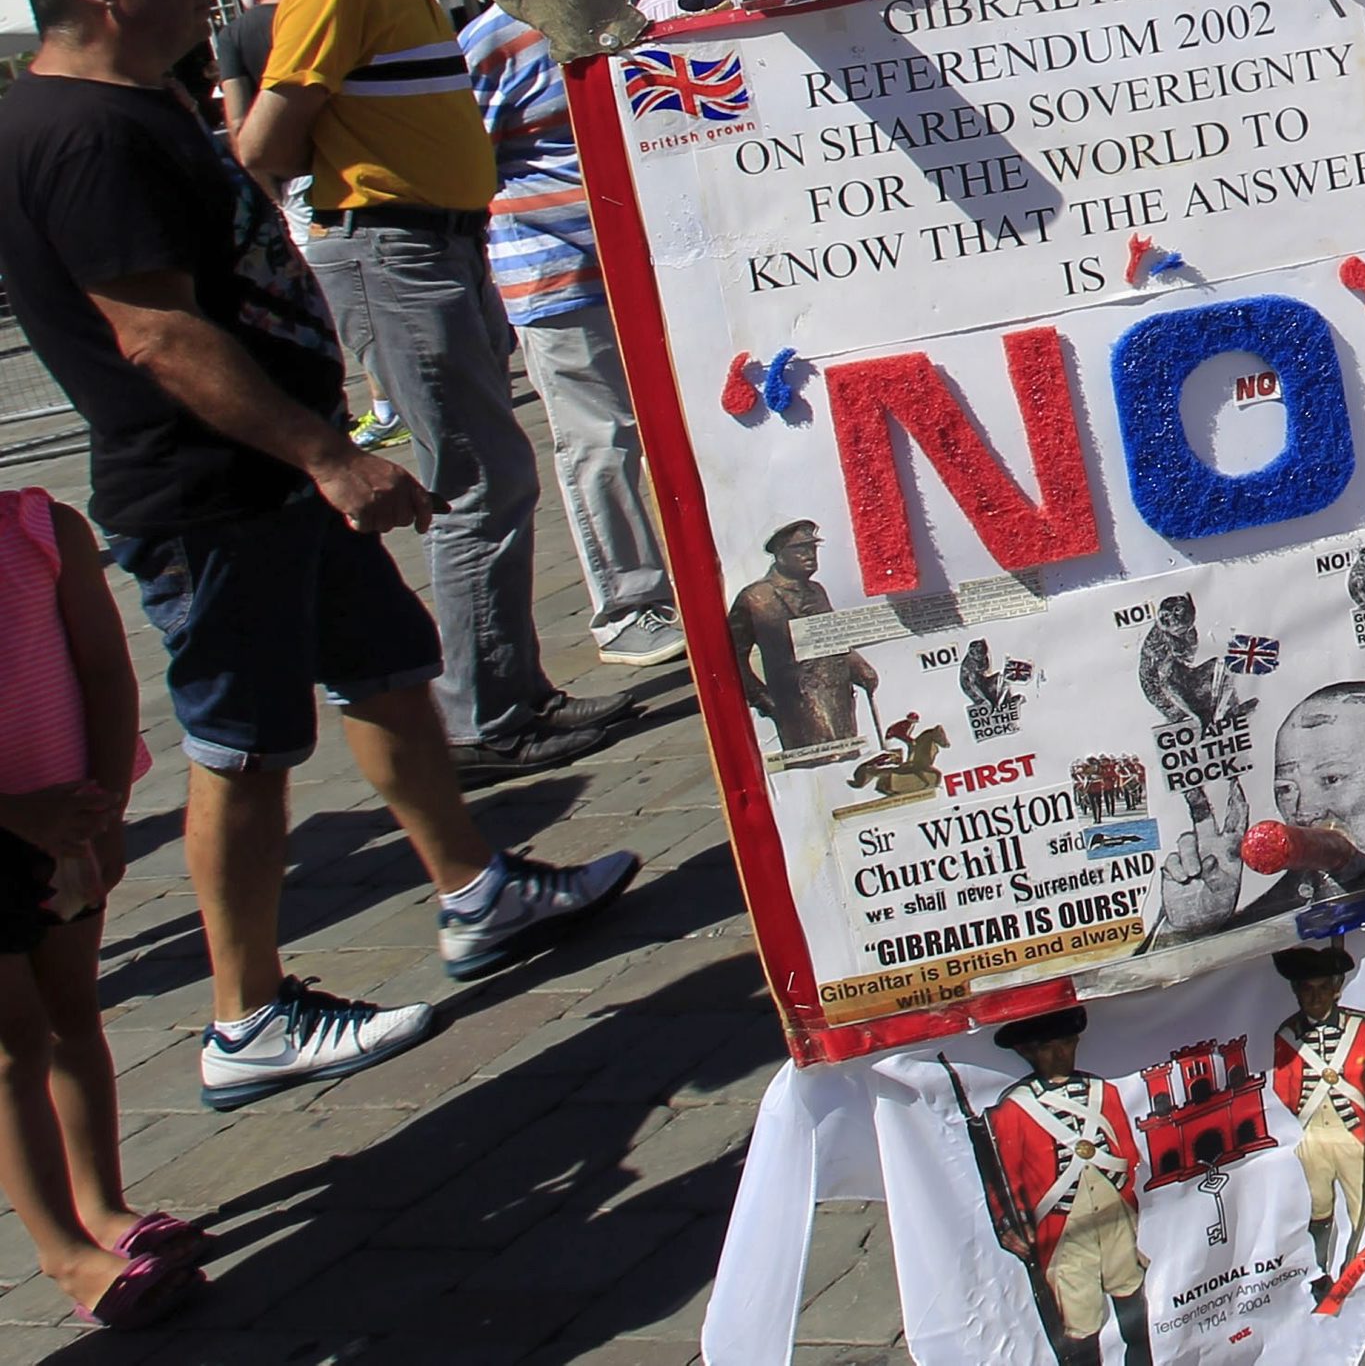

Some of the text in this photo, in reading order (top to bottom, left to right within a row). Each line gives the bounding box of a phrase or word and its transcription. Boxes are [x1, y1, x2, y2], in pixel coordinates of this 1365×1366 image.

[802, 0, 1278, 108] REFERENDUM 2002
[733, 41, 1358, 179] ON SHARED SOVEREIGNTY
[638, 132, 702, 155] British
[805, 104, 1312, 223] FOR THE WORLD TO
[748, 232, 906, 294] KNOW
[918, 207, 1063, 264] THAT
[1068, 189, 1169, 234] THE
[1059, 256, 1108, 296] IS
[1234, 372, 1277, 403] NO
[1316, 552, 1353, 573] NO!
[1114, 603, 1153, 628] NO!
[920, 648, 960, 669] NO!
[971, 711, 1019, 729] ON THE
[1156, 727, 1195, 750] GO
[1161, 732, 1253, 770] ON THE
[943, 754, 1037, 798] FIRST
[854, 830, 1086, 899] Churchill said
[903, 853, 1154, 915] shall never Surrender AND
[1026, 906, 1054, 935] IS
[820, 920, 1144, 1003] Gibraltar is British and always
[939, 983, 966, 1000] be
[1154, 1293, 1233, 1335] Tercentenary
[1236, 1266, 1310, 1298] Anniversary
[1172, 1254, 1285, 1308] NATIONAL DAY
[1198, 1295, 1271, 1334] 1704 2004
